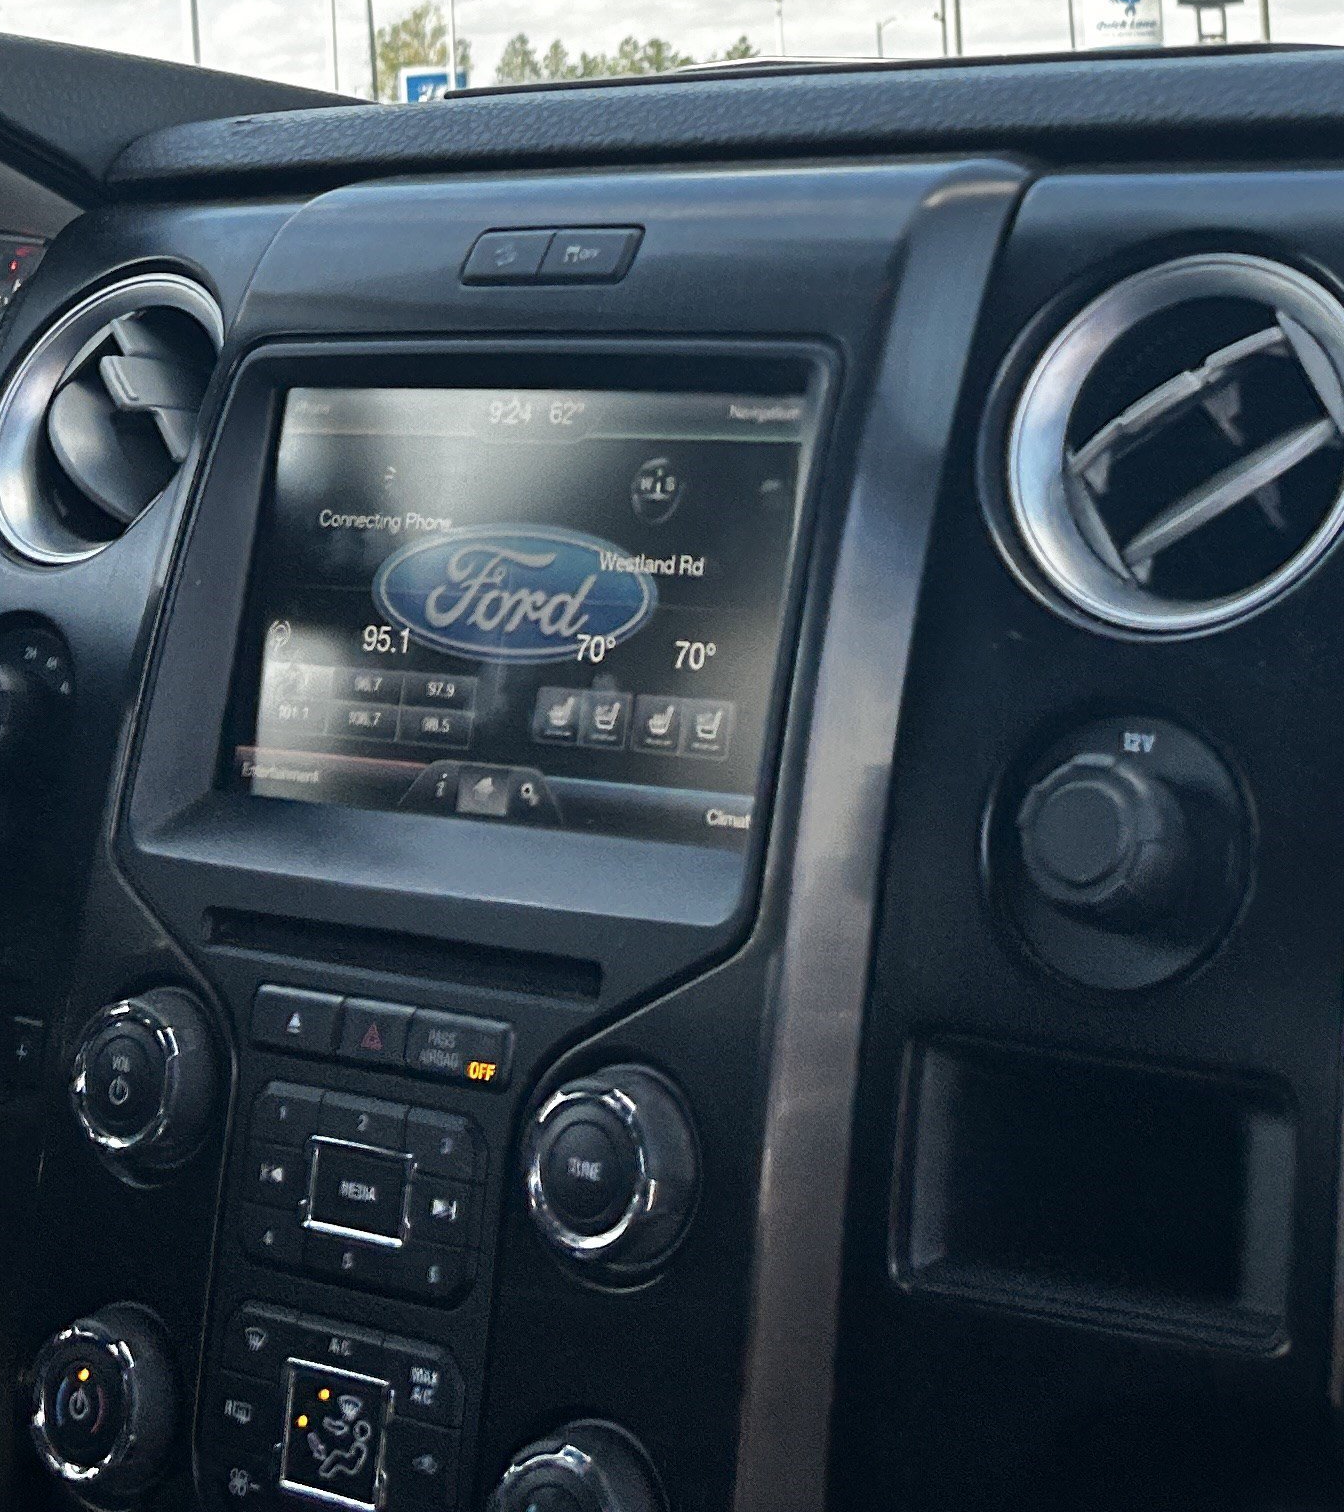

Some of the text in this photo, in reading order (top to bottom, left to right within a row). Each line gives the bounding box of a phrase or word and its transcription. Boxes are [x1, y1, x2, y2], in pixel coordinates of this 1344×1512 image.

[319, 508, 402, 535] Connecting
[599, 551, 705, 576] Westland Rd
[424, 544, 597, 638] Ford
[362, 624, 410, 653] 95.1
[576, 633, 616, 663] 70°
[674, 640, 717, 670] 70°
[427, 1028, 457, 1049] PASS
[467, 1060, 497, 1082] OFF
[339, 1179, 377, 1202] MEDIA
